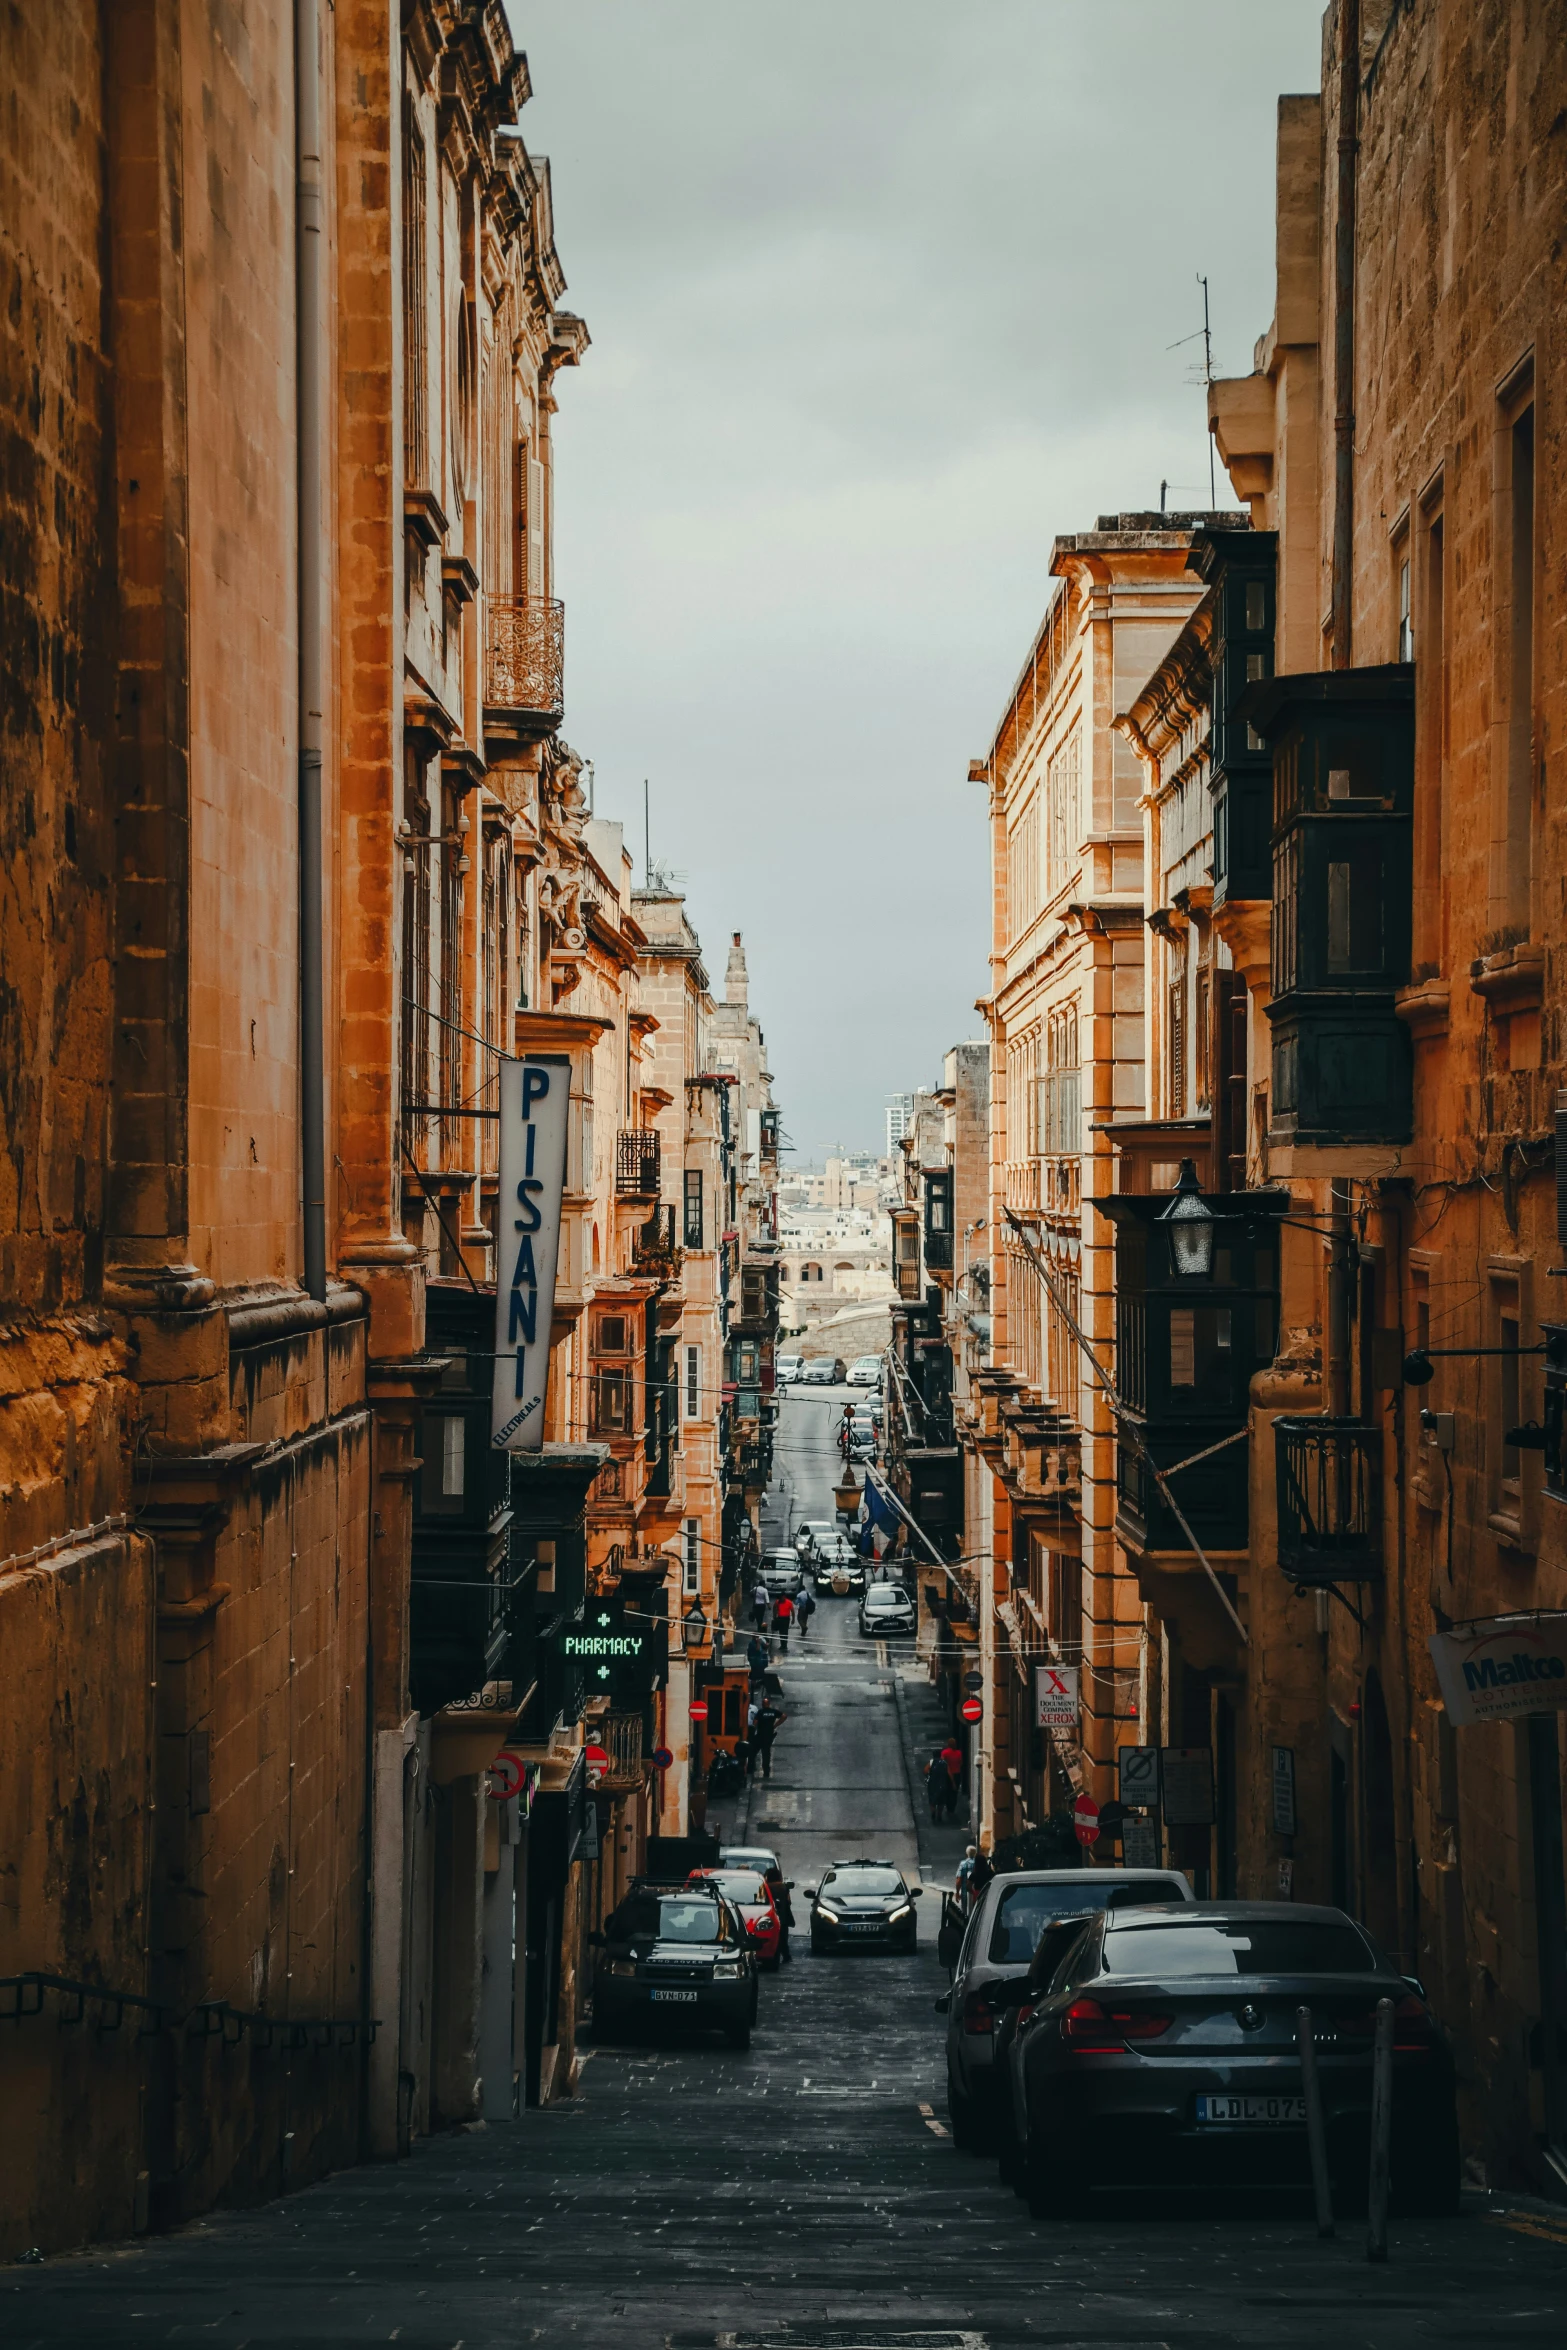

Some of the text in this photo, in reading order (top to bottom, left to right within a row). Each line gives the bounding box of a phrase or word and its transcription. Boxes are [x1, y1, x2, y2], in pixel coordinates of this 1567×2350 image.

[508, 1067, 549, 1398] PISANI
[492, 1396, 541, 1447] ELECTRICALS
[565, 1637, 642, 1655] PHARMACY
[1462, 1653, 1565, 1691] Maltco
[1040, 1713, 1076, 1724] XEROX
[1475, 1696, 1542, 1714] AUTHORISED
